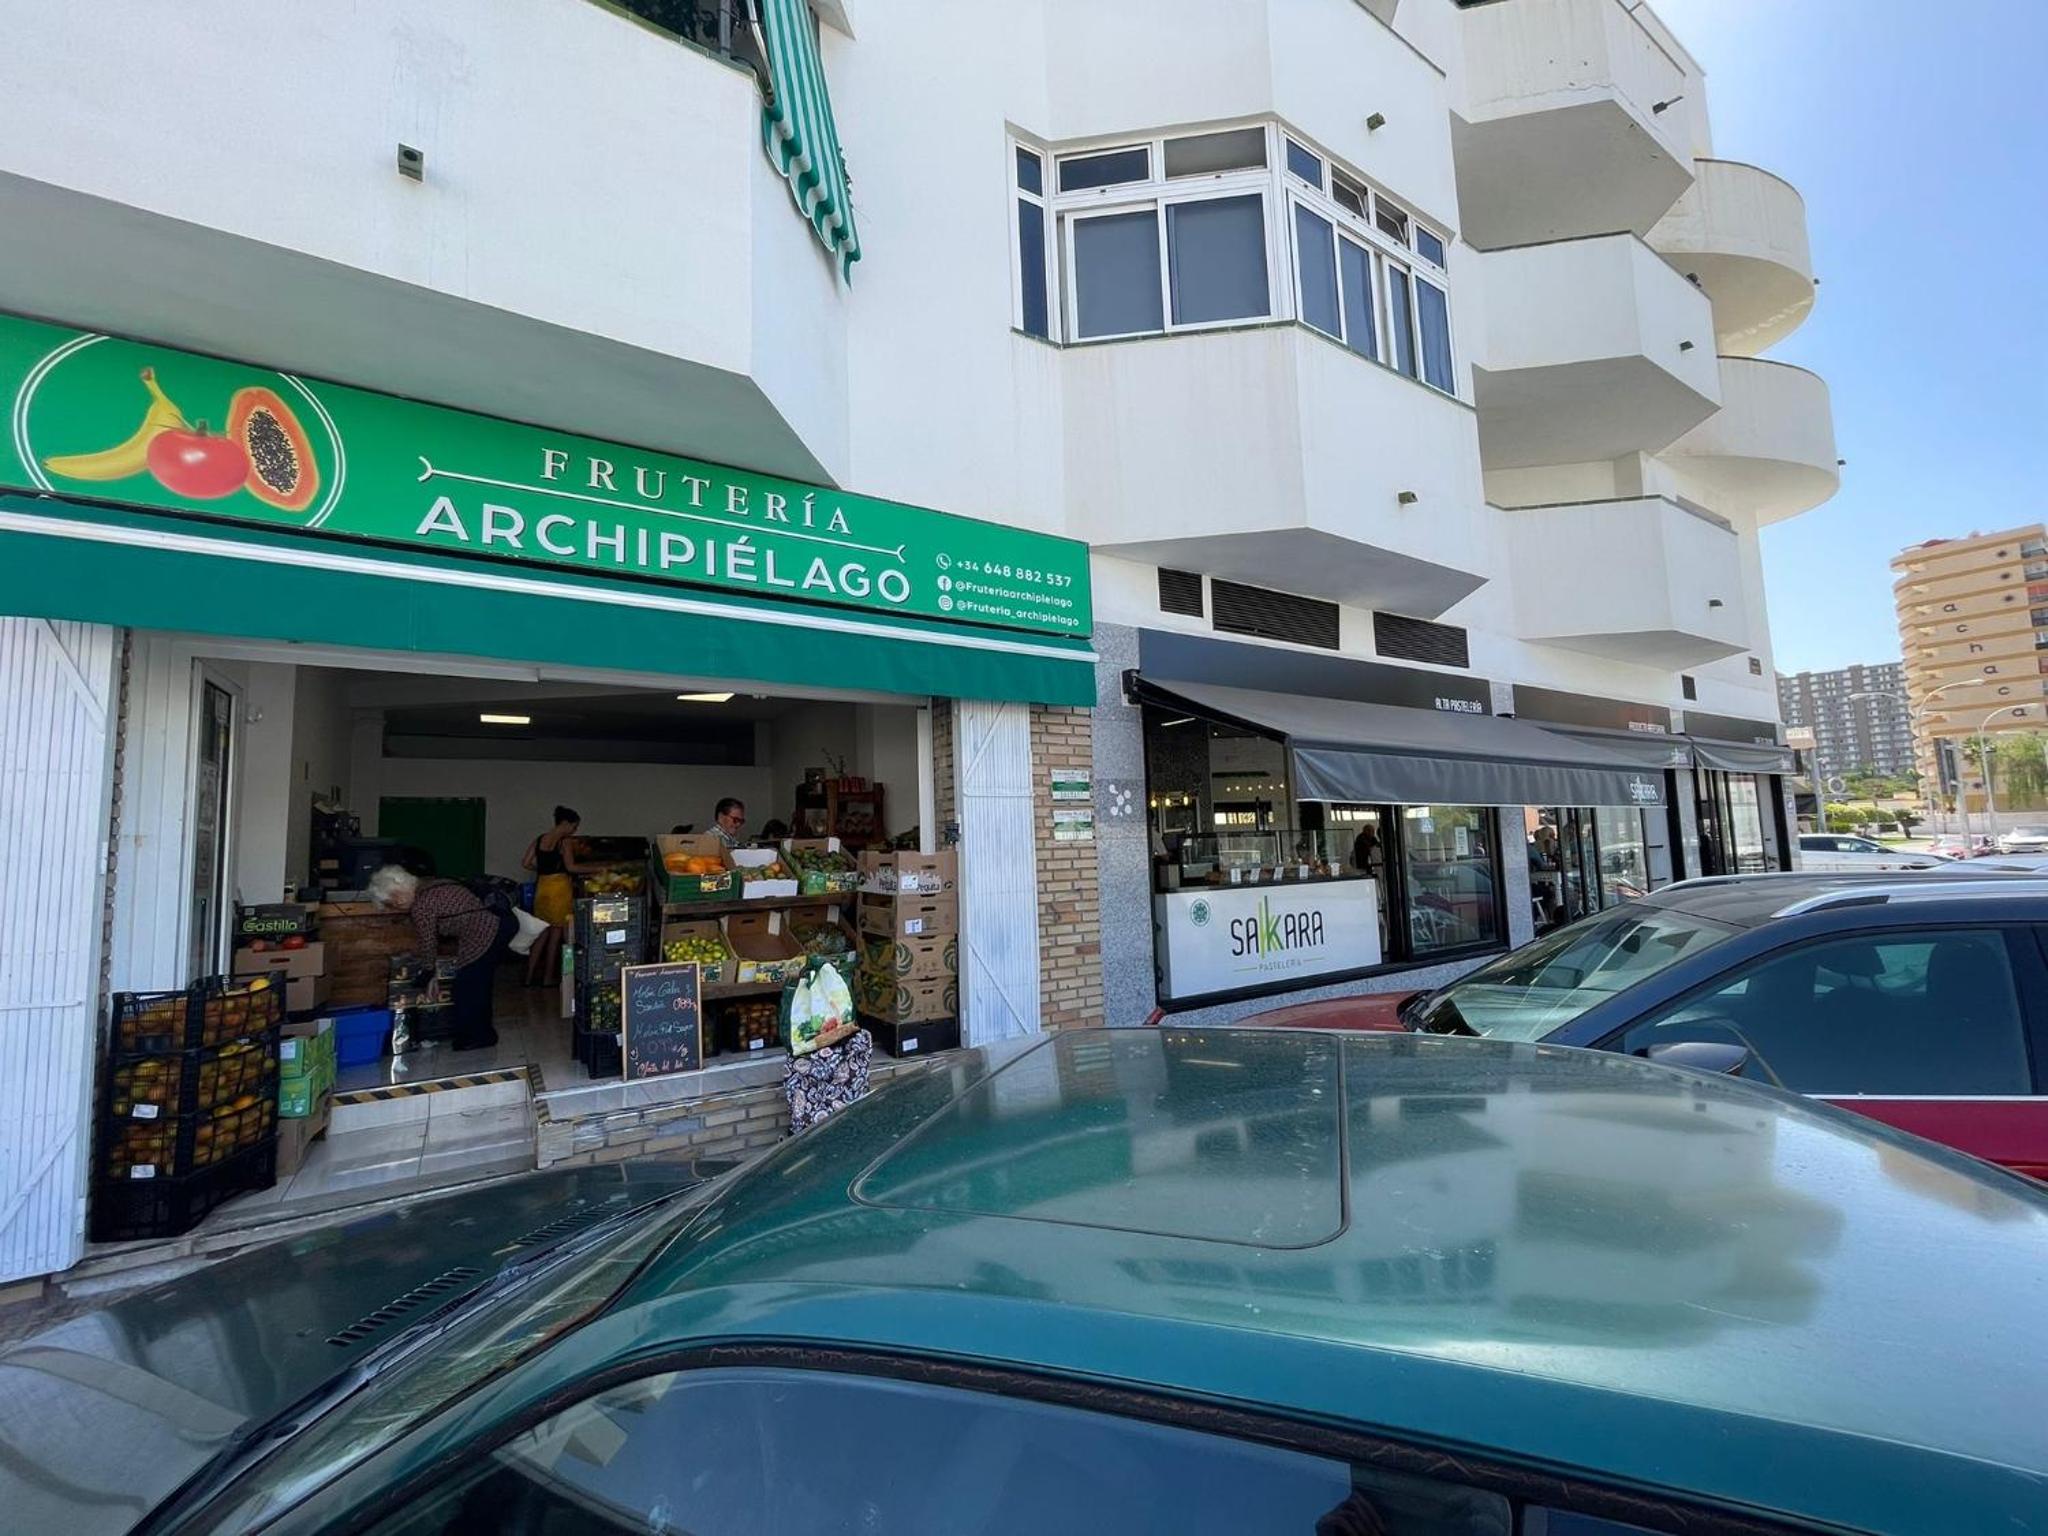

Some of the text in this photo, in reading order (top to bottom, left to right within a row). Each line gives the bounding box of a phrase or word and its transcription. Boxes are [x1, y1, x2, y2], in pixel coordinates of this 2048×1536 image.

[540, 448, 852, 535] FRUTERÍA
[415, 496, 911, 603] ARCHIPIÉLAGO
[956, 560, 1072, 588] +34 648 882 537
[1230, 895, 1325, 960] SAKARA
